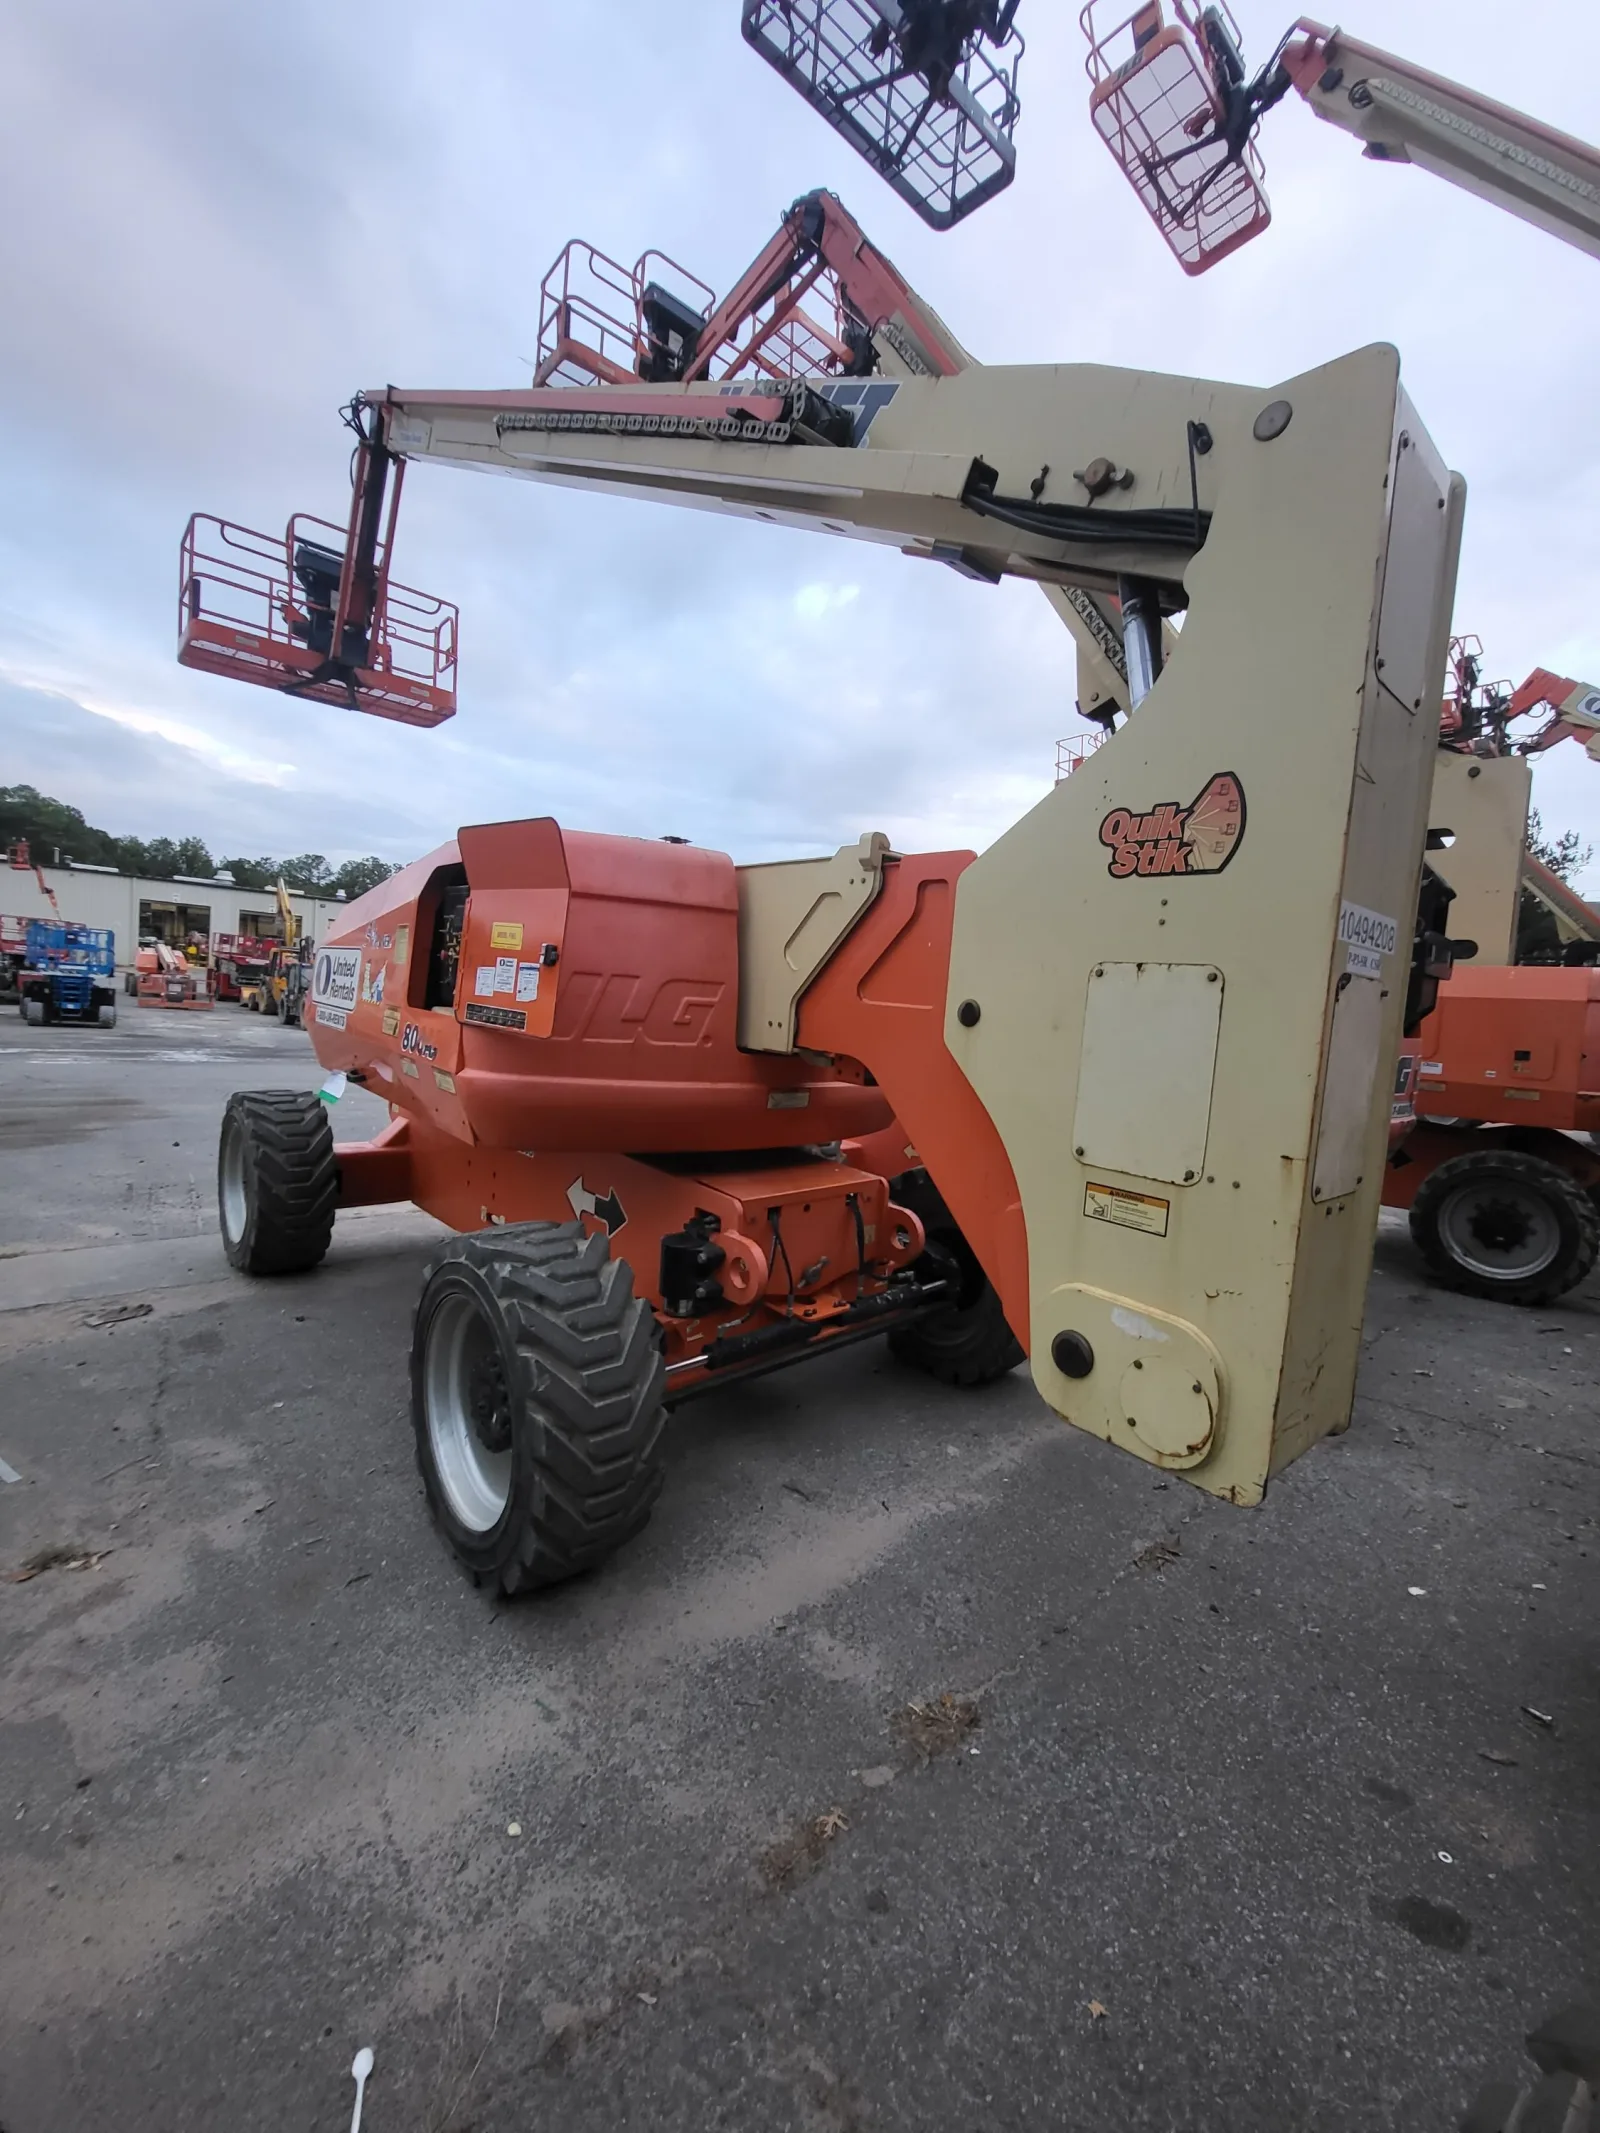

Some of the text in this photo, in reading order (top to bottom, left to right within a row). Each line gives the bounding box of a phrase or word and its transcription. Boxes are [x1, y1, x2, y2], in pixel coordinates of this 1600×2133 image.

[1101, 805, 1188, 848] Quik
[1110, 839, 1193, 876] Stik
[1340, 908, 1396, 953] 10494208
[332, 956, 358, 978] United
[329, 978, 356, 1002] Rentals
[1114, 1190, 1145, 1203] WARNING
